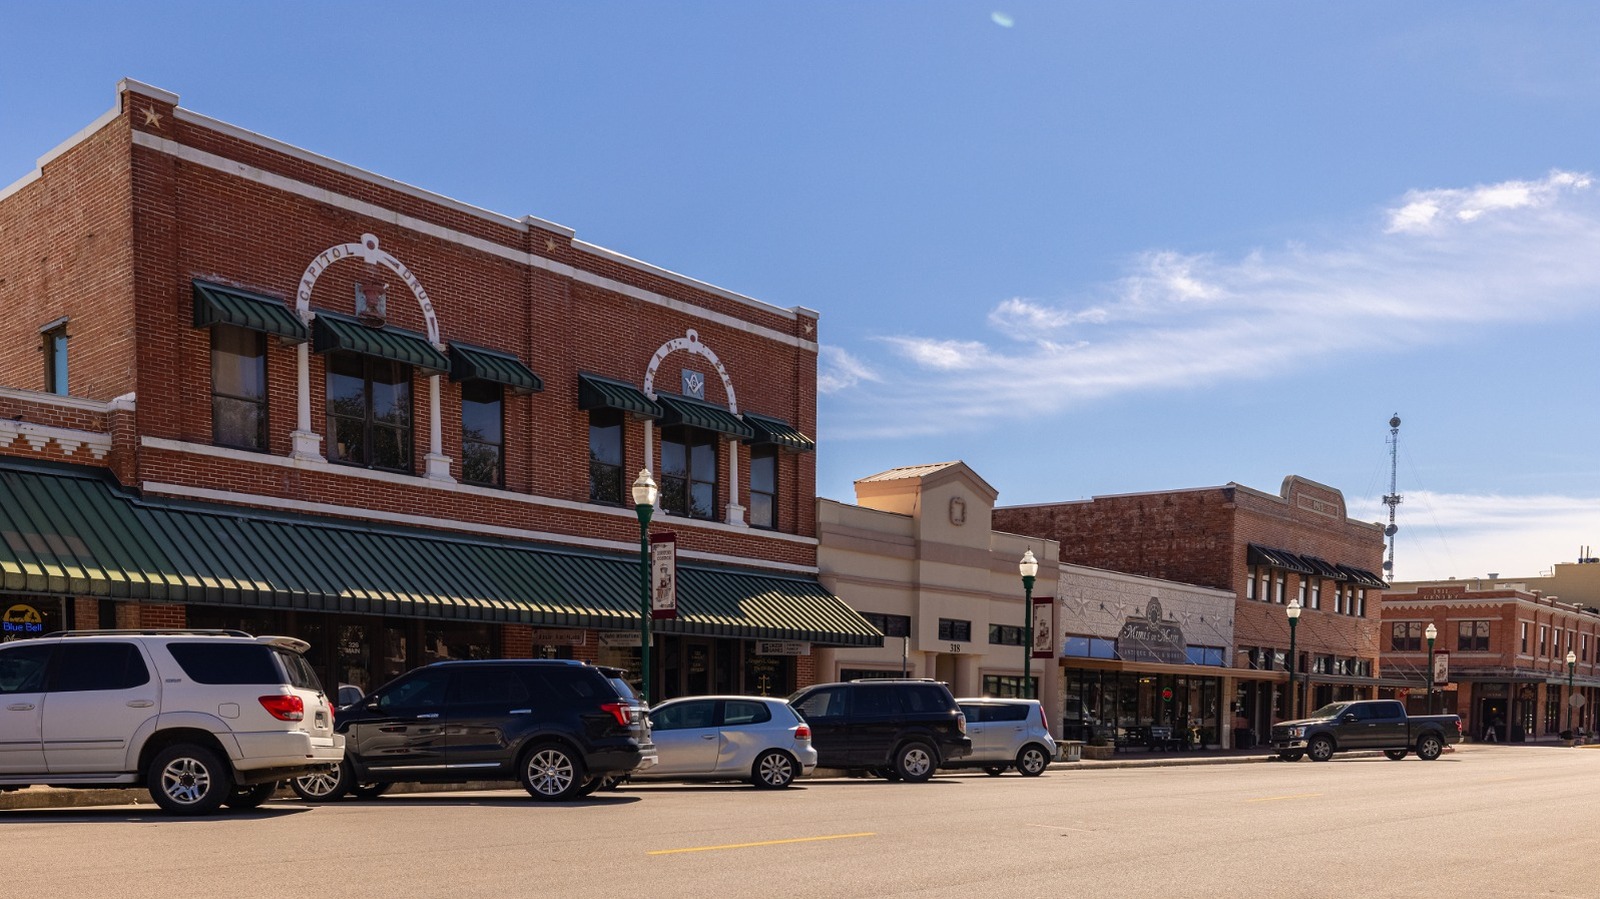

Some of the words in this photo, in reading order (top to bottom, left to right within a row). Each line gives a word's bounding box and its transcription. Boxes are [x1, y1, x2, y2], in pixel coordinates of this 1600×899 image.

[299, 244, 354, 302] CAPITOL
[402, 269, 434, 313] DRUG
[3, 621, 23, 631] Blue
[25, 621, 42, 632] Bell
[950, 643, 961, 653] 318
